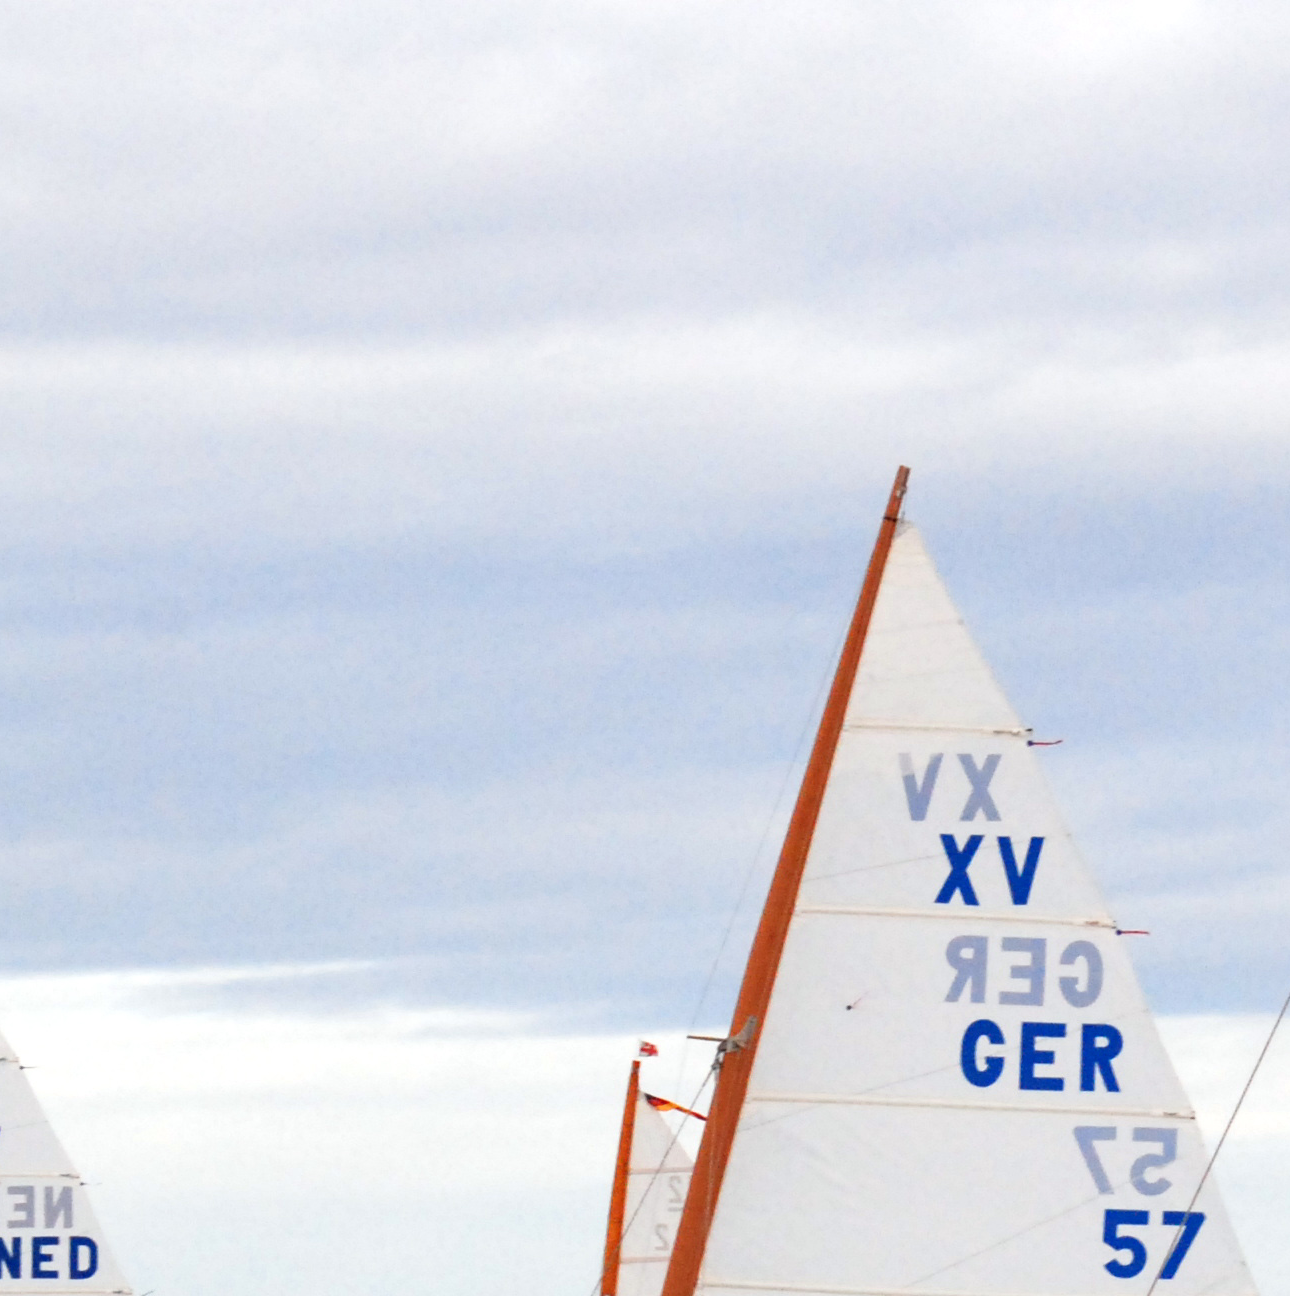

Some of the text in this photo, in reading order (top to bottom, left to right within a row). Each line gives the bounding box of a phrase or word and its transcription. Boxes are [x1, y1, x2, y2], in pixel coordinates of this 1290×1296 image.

[935, 834, 1044, 906] XV
[961, 1020, 1123, 1092] GER
[1103, 1209, 1205, 1280] 57
